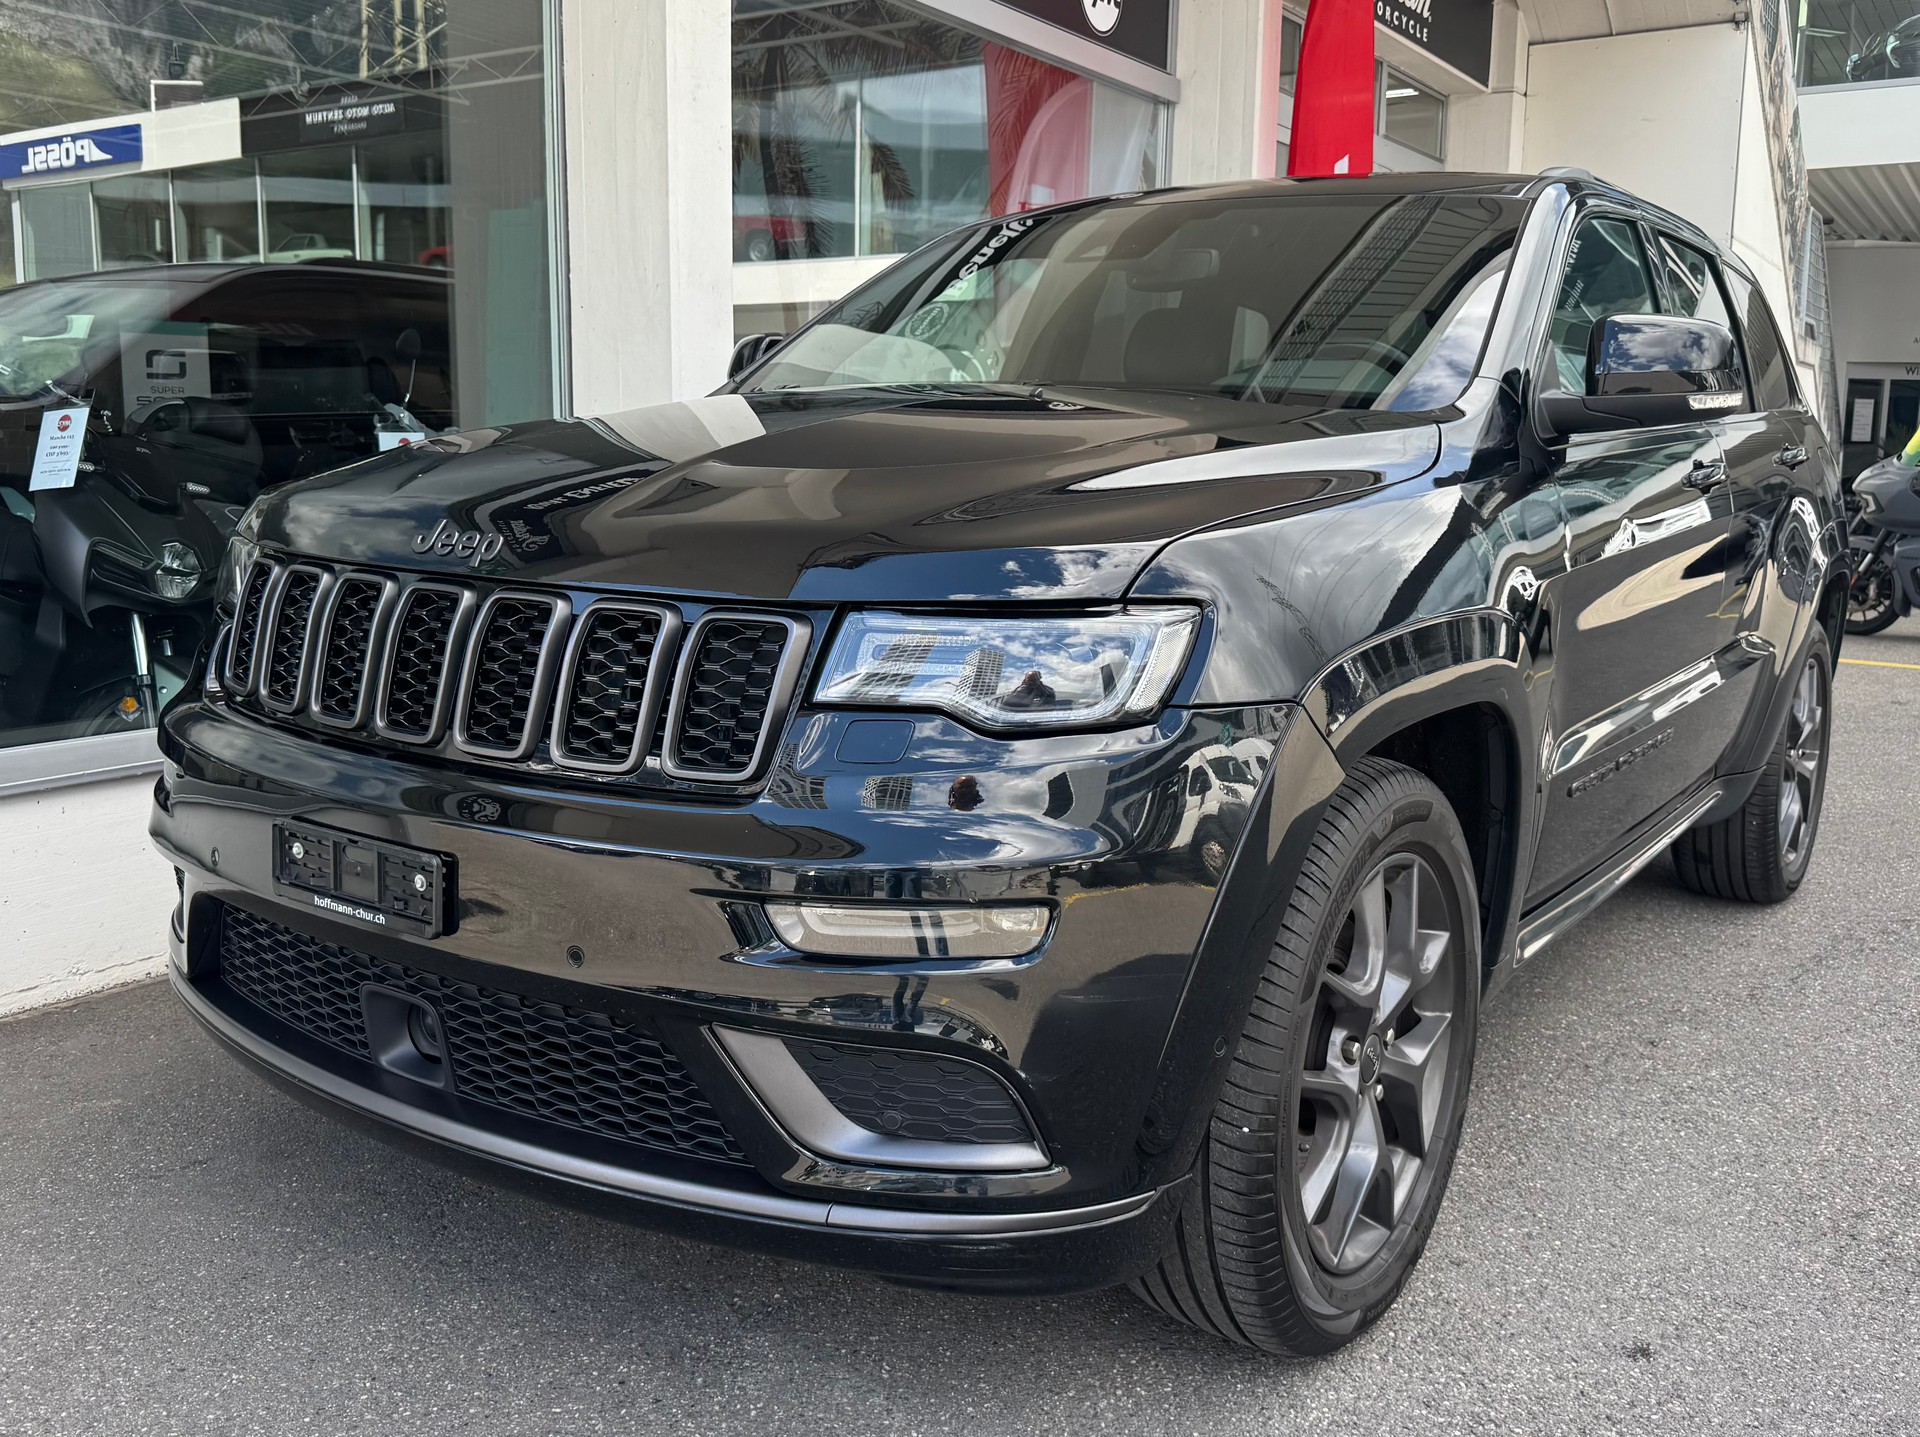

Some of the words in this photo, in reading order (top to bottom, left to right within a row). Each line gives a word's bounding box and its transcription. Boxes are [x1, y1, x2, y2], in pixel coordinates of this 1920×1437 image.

[1376, 1, 1429, 42] ORCYCLE
[150, 385, 185, 395] SUPER
[410, 518, 504, 568] Jeep
[314, 895, 386, 925] hoffmann-chur.ch
